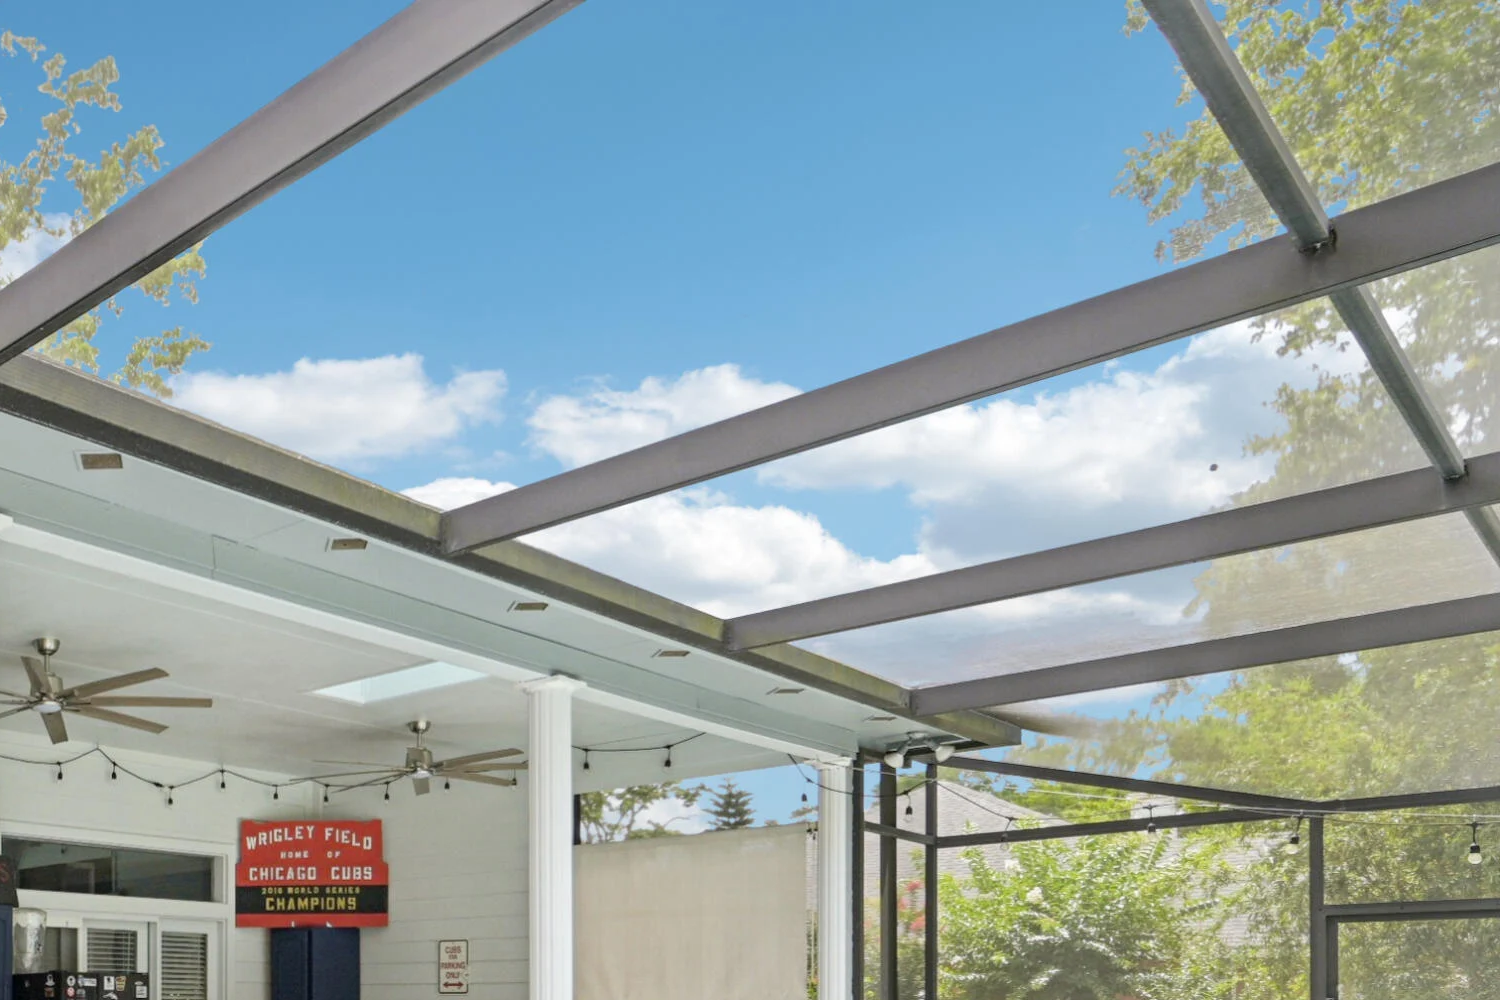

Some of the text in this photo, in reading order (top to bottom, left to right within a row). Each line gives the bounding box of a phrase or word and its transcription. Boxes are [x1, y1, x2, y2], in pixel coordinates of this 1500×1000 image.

[246, 825, 372, 850] WRIGLEY FIELD
[280, 851, 341, 859] HOME OF
[249, 866, 373, 881] CHICAGO CUBS
[261, 887, 283, 895] 2016
[325, 886, 360, 894] SERIES
[265, 897, 357, 911] CHAMPIONS
[441, 961, 466, 969] PARKING
